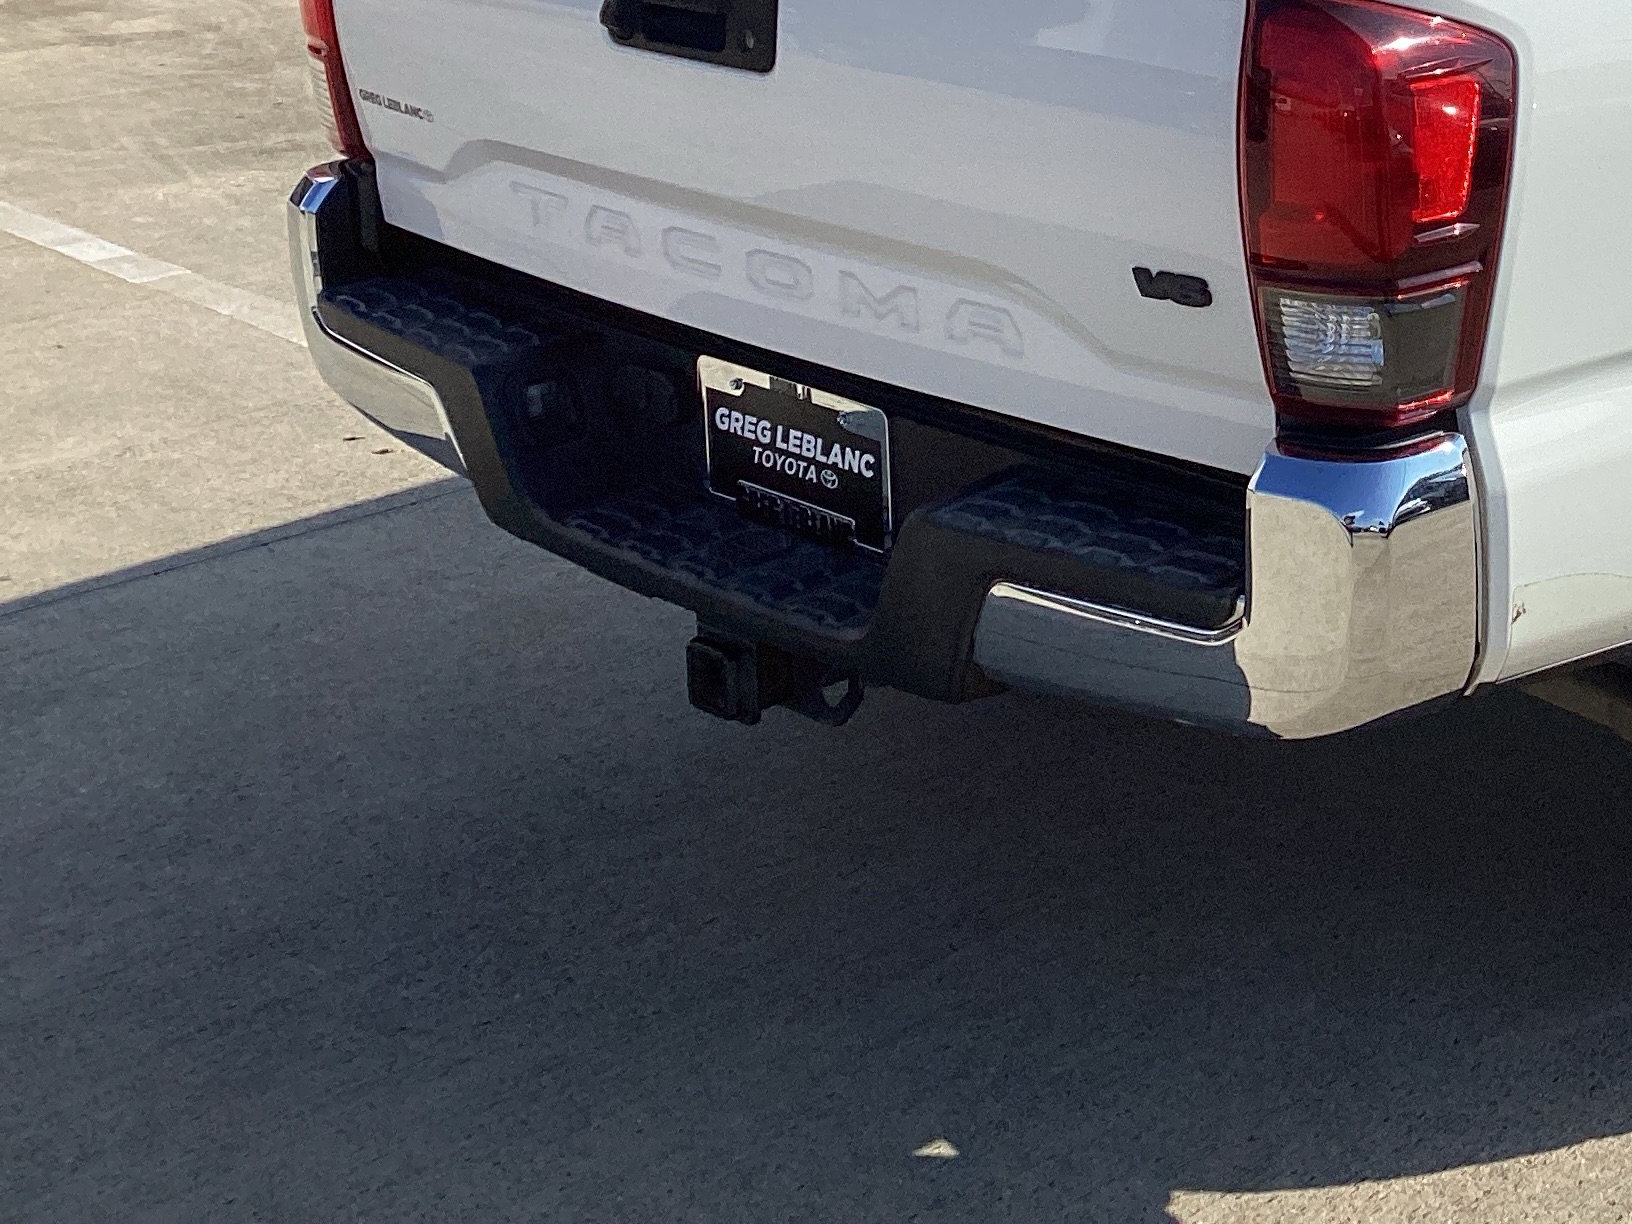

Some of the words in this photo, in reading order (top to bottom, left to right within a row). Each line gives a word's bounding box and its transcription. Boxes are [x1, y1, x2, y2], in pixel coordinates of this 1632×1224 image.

[509, 180, 1025, 360] TACOMA
[1132, 266, 1213, 307] V6
[715, 406, 773, 444] GREG
[776, 425, 876, 478] LEBLANC
[752, 446, 817, 483] TOYOTA
